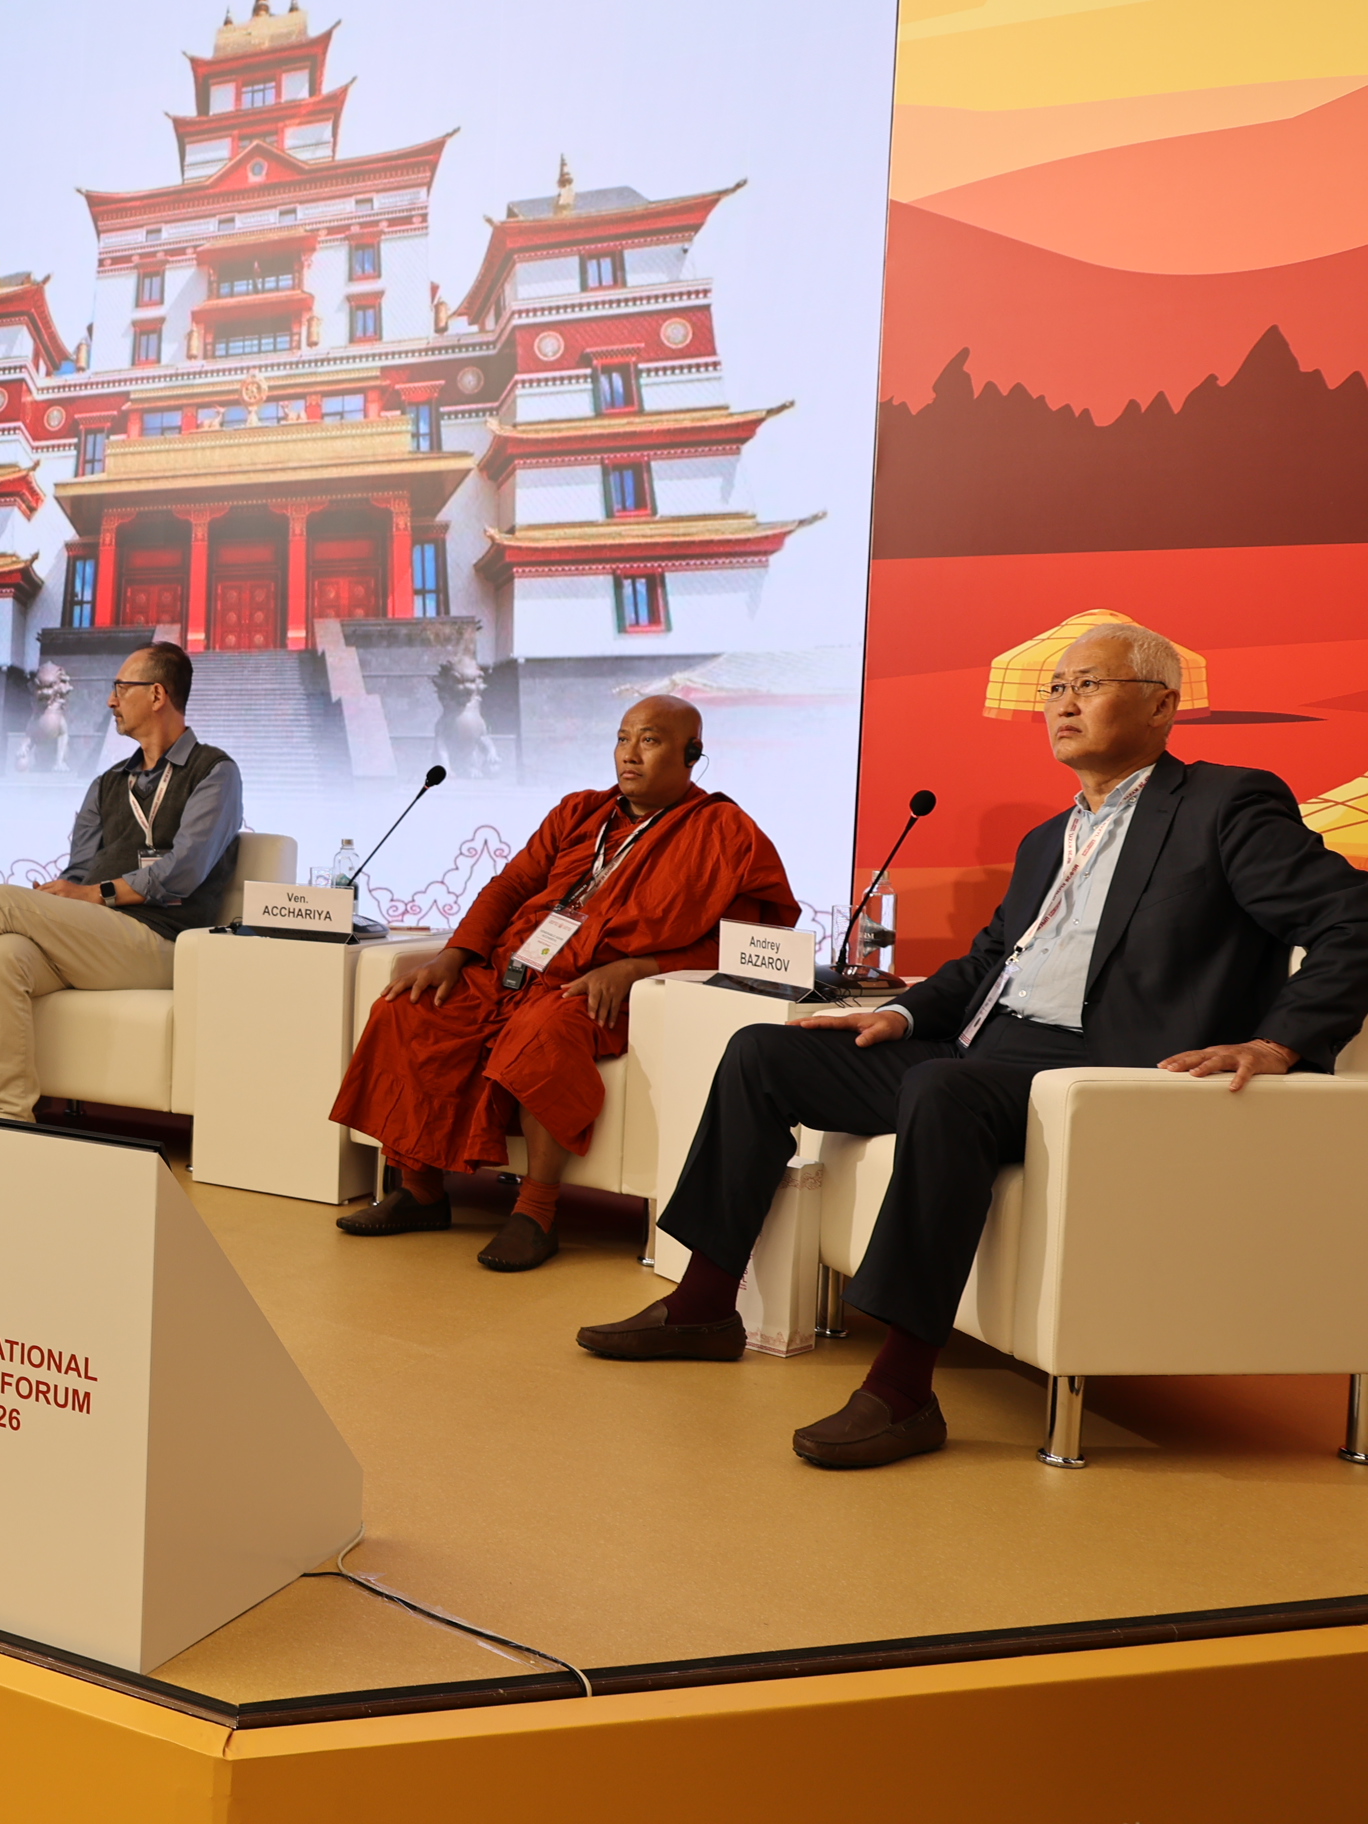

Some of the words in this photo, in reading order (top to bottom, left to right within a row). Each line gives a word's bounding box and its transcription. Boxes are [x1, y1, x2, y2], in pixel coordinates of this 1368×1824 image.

[287, 892, 308, 903] Ven.
[262, 905, 332, 921] ACCHARIYA
[749, 936, 781, 954] Andrey
[740, 952, 790, 972] BAZAROV
[0, 1371, 91, 1415] FORUM
